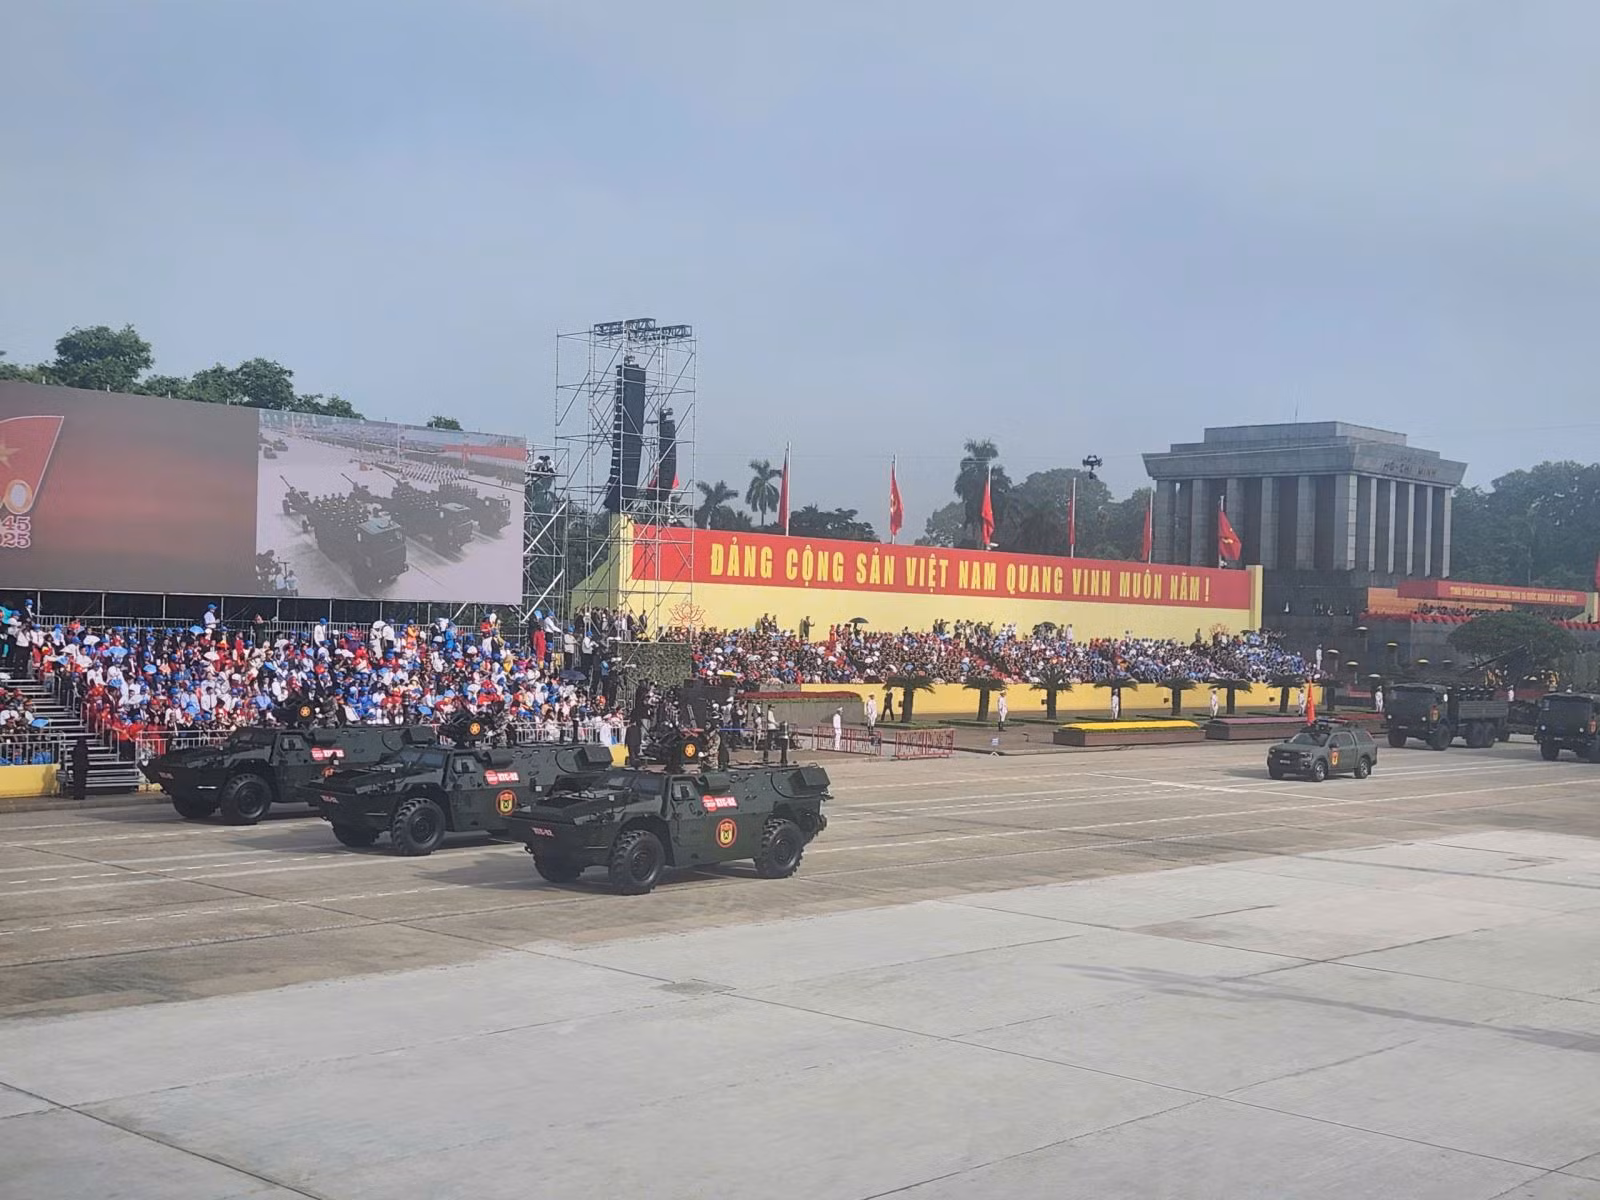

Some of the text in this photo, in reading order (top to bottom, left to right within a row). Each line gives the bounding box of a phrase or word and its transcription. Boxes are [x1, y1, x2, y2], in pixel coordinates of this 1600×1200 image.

[0, 533, 31, 548] 25
[710, 536, 773, 579] ĐẢNG
[786, 544, 845, 587] CỘNG
[856, 547, 896, 585] SẢN
[906, 553, 949, 593] VIỆT
[958, 560, 997, 591] NAM
[1006, 563, 1063, 595] QUANG
[1072, 568, 1112, 597] VINH
[1119, 569, 1163, 600] MUÔN
